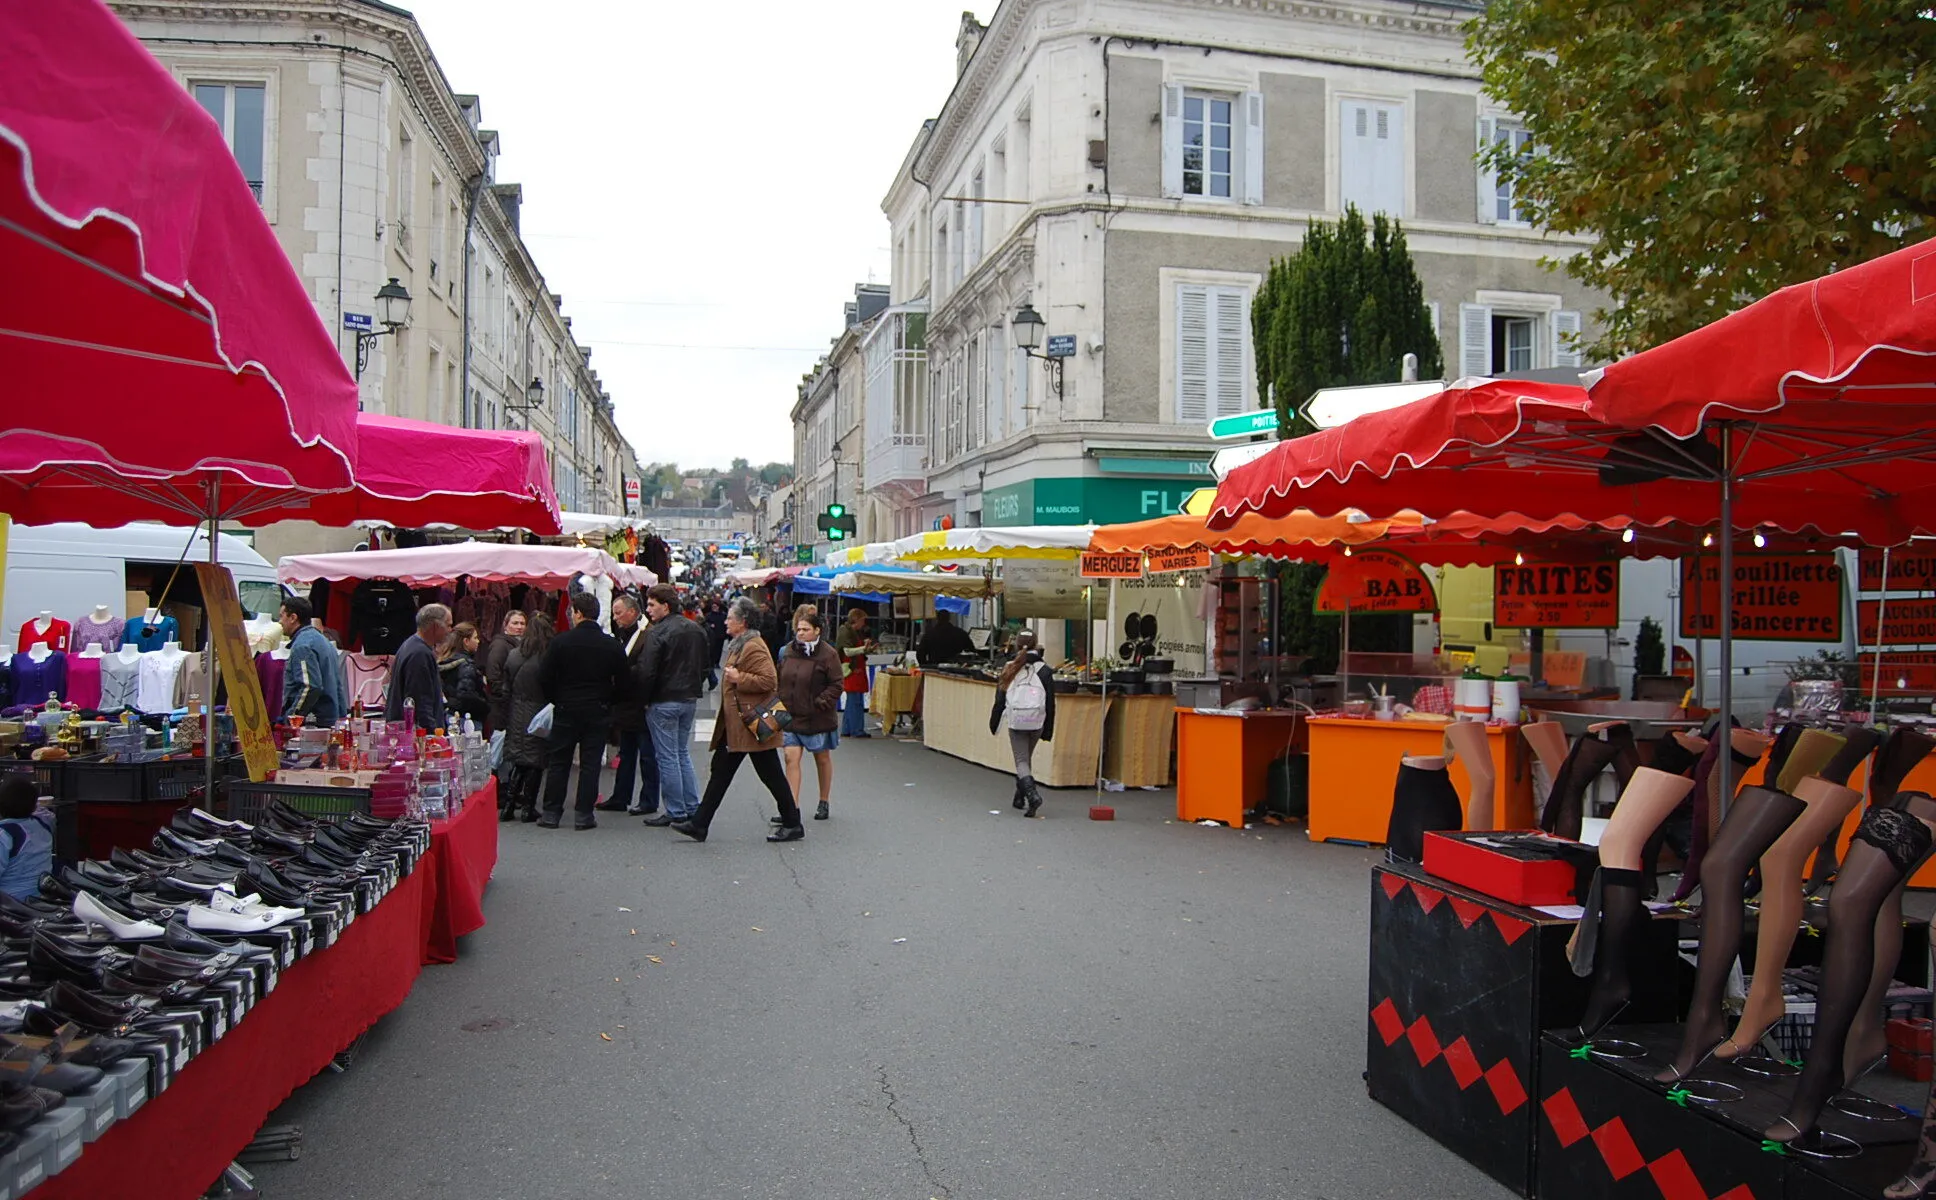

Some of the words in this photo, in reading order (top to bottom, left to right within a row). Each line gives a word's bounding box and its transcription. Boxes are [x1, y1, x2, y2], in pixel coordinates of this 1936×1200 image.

[1252, 414, 1280, 428] POITIE
[995, 494, 1019, 519] FLEURS
[1147, 544, 1208, 559] SANDWICHS
[1083, 556, 1140, 573] MERGUEZ
[1161, 556, 1198, 569] VARIES
[1688, 560, 1842, 582] Anouillette
[1499, 565, 1614, 596] FRITES
[1731, 586, 1800, 606] rillée
[1689, 614, 1714, 630] au
[1731, 610, 1834, 633] Sancerre
